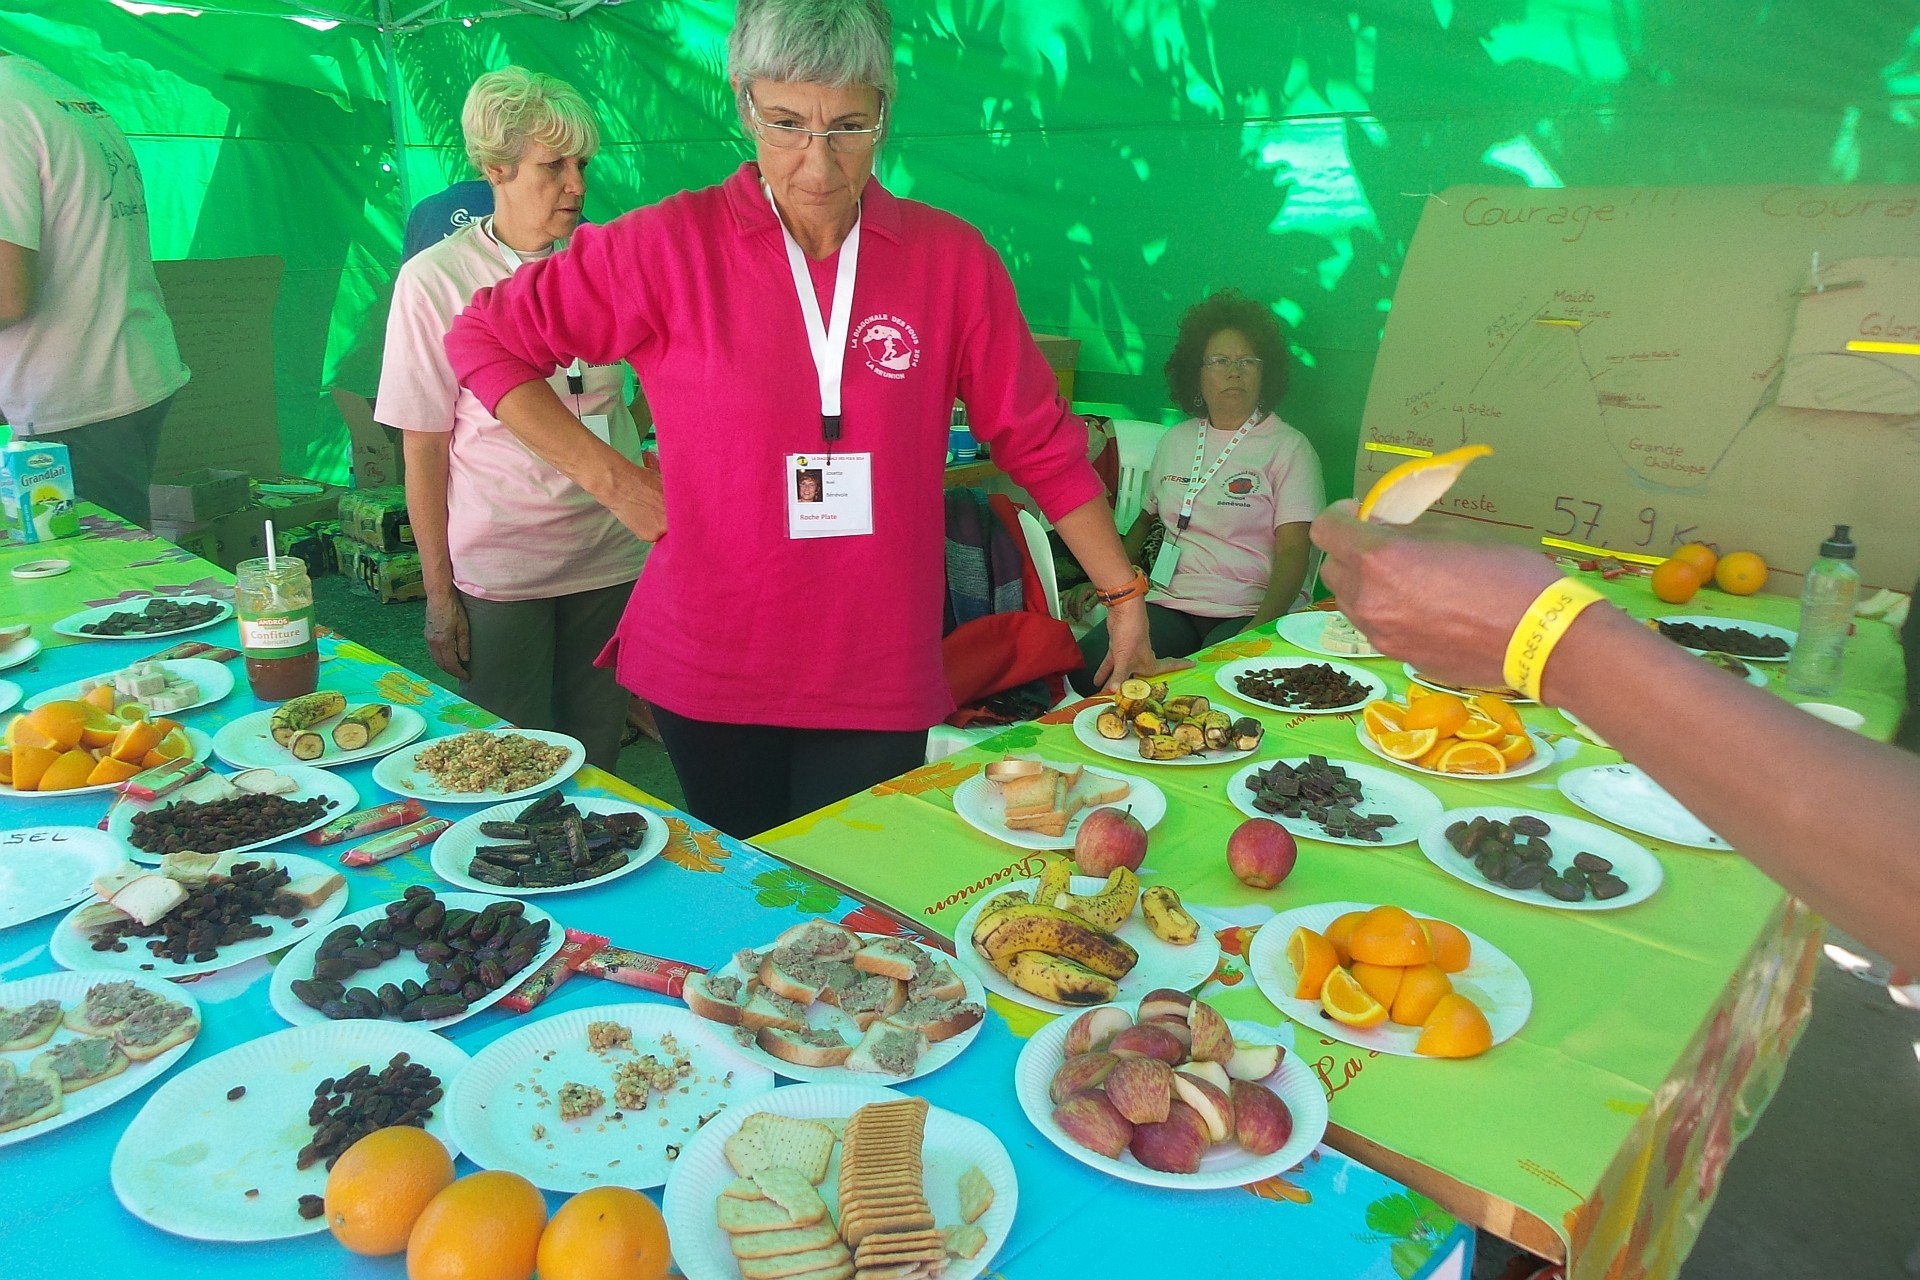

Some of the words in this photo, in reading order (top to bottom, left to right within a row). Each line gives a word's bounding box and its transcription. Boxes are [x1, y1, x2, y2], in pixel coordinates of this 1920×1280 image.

[853, 313, 888, 338] DIAGONALE
[891, 315, 906, 328] DES
[850, 338, 858, 349] LA
[1629, 437, 1685, 457] Grande
[1454, 495, 1498, 513] reste
[1633, 507, 1657, 547] 9
[258, 618, 288, 626] ANDROS
[1523, 632, 1543, 660] DES
[1538, 594, 1573, 631] FOUS
[250, 629, 301, 640] Confiture
[3, 832, 70, 845] SEL
[1308, 1055, 1363, 1103] La
